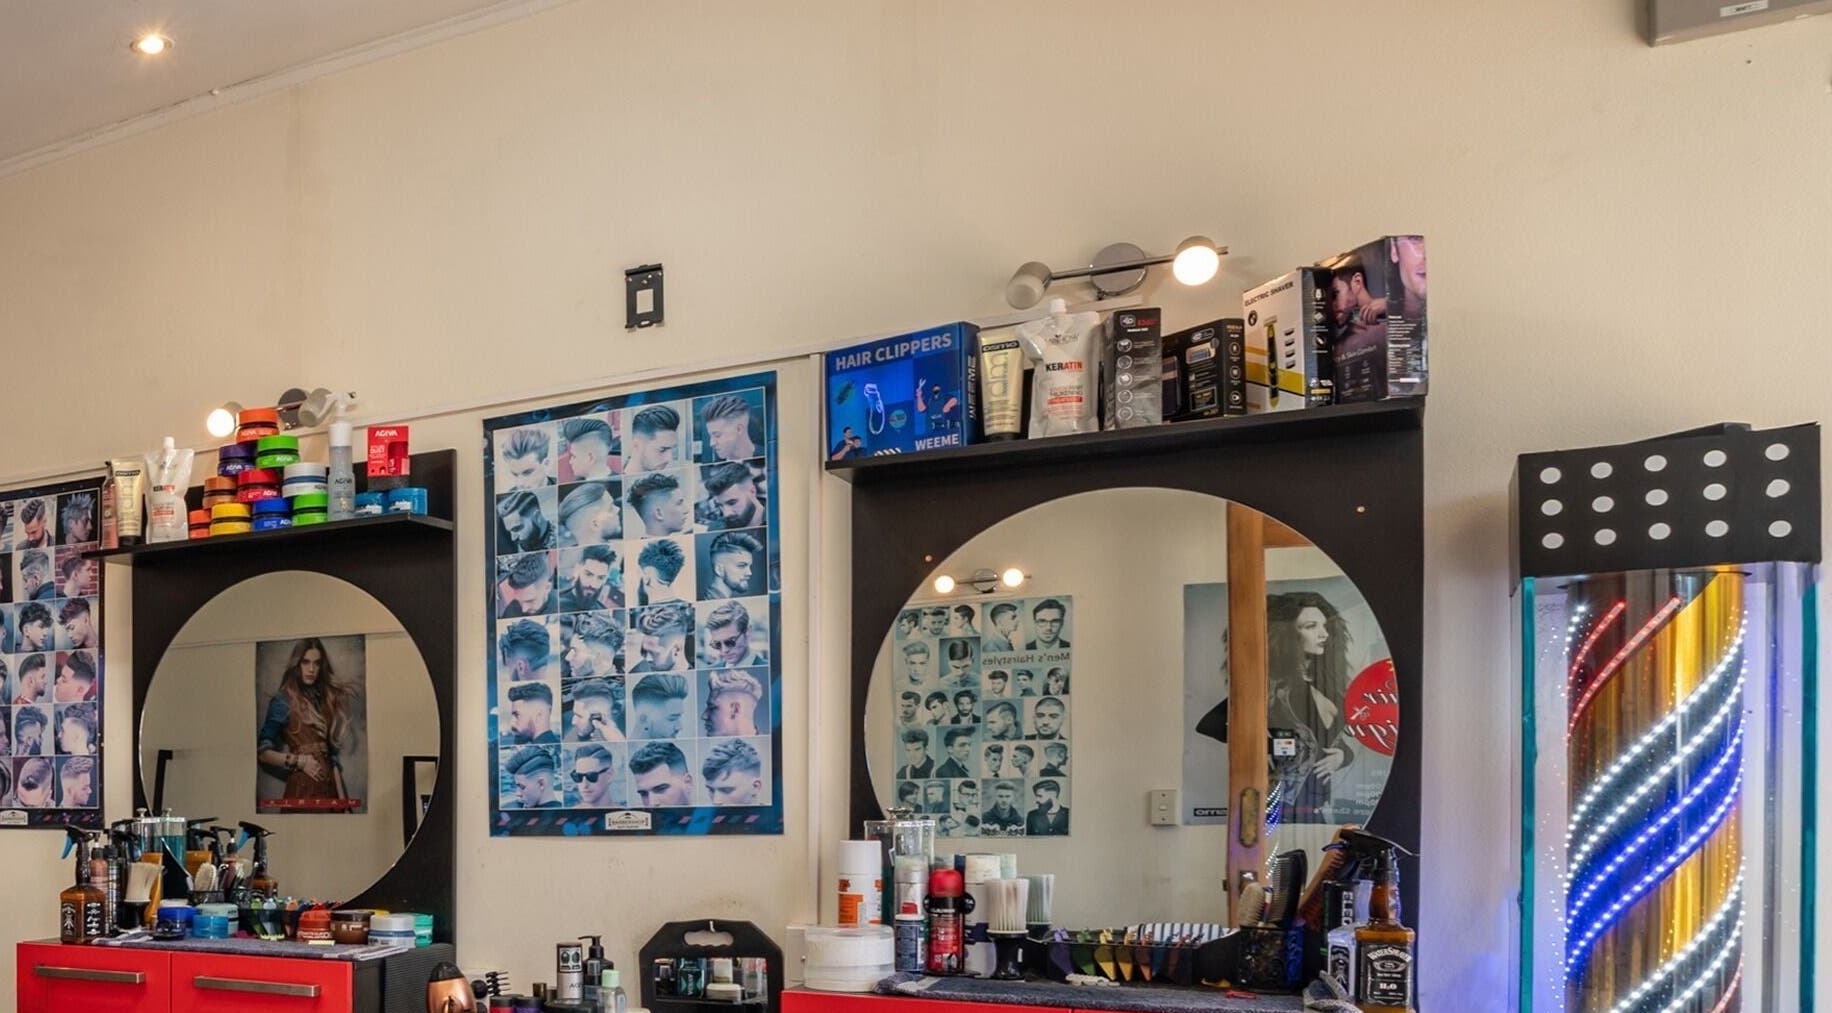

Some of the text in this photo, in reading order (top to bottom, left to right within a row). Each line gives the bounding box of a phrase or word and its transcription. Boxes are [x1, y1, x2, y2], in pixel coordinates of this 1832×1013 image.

[835, 333, 952, 371] HAIR CLIPPERS
[1046, 361, 1083, 372] KERATIN
[914, 434, 959, 451] WEEME
